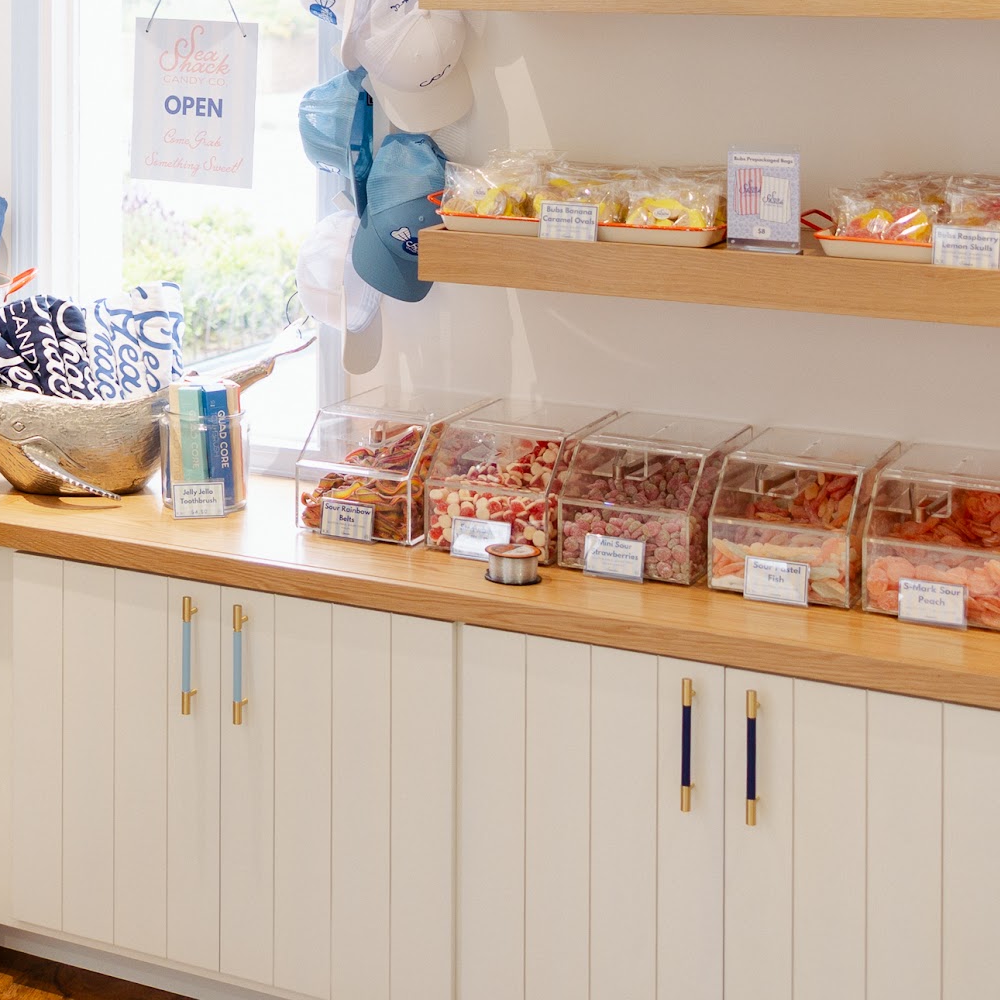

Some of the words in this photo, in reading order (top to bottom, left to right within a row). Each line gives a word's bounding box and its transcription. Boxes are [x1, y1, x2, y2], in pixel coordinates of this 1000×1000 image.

[176, 24, 219, 62] Sea
[159, 38, 231, 76] Shack
[163, 75, 205, 86] CANDY
[164, 95, 223, 118] OPEN
[163, 128, 191, 147] Come
[188, 130, 223, 150] Grab
[145, 151, 201, 178] Something
[202, 155, 244, 175] Sweet!
[546, 205, 564, 215] Bubs
[565, 207, 593, 216] Banana
[542, 215, 574, 224] Caramel
[574, 217, 596, 226] Ovals
[957, 232, 999, 244] Raspberry
[941, 241, 968, 250] Lemon
[969, 243, 993, 252] Skulls
[9, 300, 42, 377] CANDY
[217, 409, 228, 439] QUAD
[191, 441, 200, 469] CORE
[220, 441, 230, 469] CORE
[183, 488, 197, 497] Jelly
[198, 488, 214, 496] Jello
[180, 497, 218, 505] Toothbrush
[325, 503, 341, 512] Sour
[341, 506, 371, 516] Rainbow
[339, 514, 355, 523] Belts
[615, 541, 633, 550] Sour
[591, 550, 639, 561] Strawberries
[752, 561, 772, 571] Sour
[767, 574, 785, 584] Fish
[903, 582, 937, 593] S-Mark
[939, 586, 961, 596] Sour
[918, 595, 946, 606] Peach
